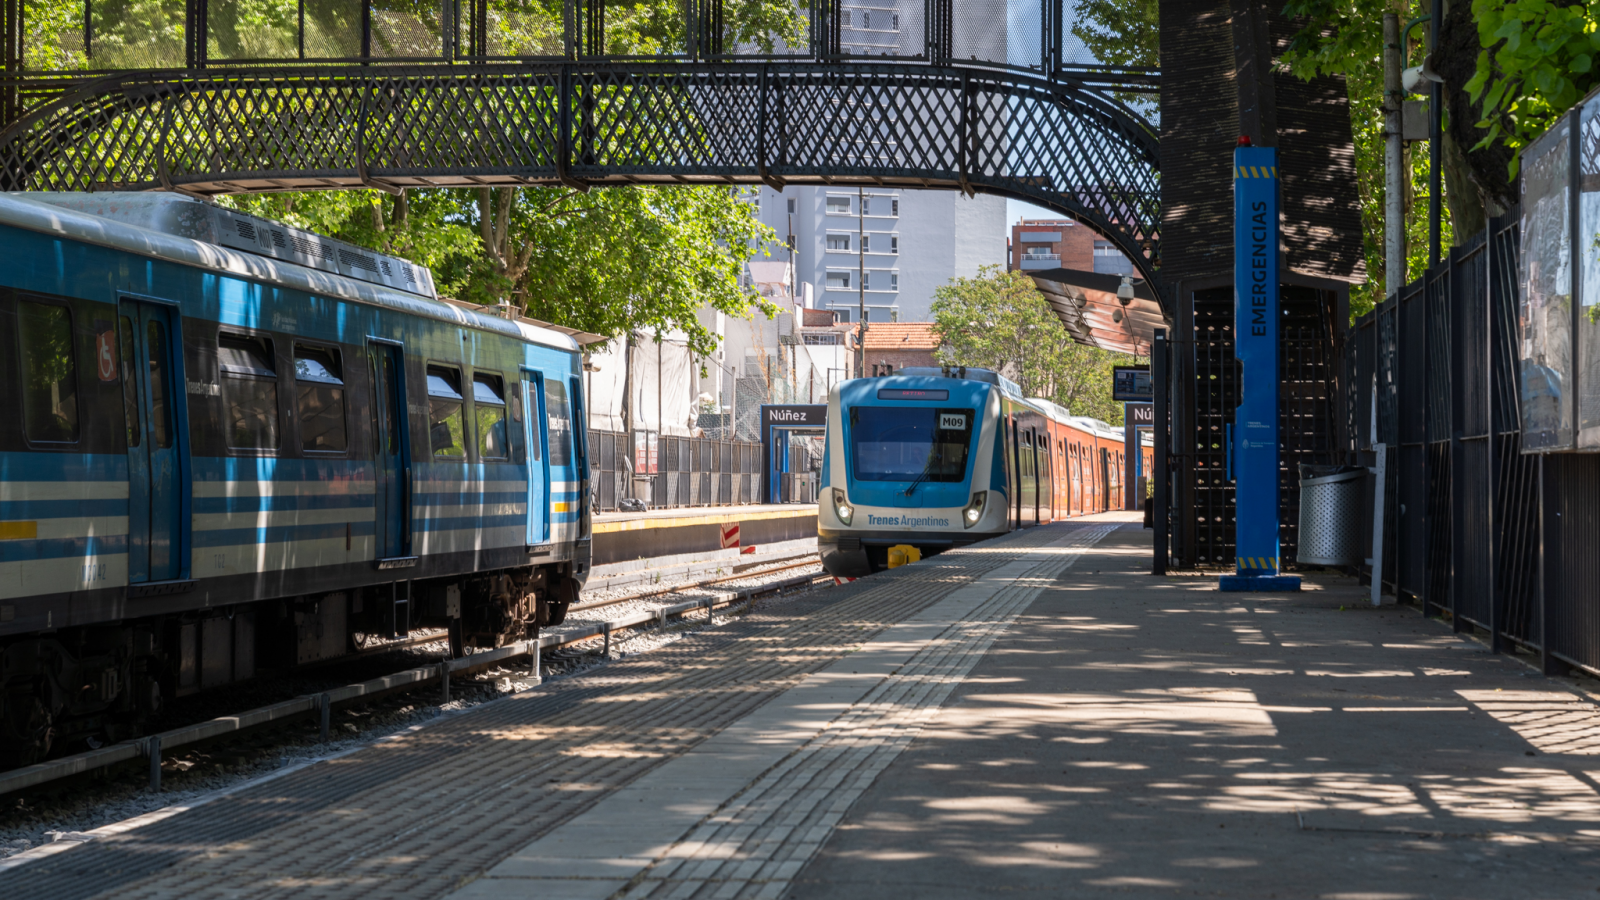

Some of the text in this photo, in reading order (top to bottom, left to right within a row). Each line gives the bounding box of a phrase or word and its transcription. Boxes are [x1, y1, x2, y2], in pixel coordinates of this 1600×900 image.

[1252, 201, 1267, 336] EMERGENCIAS
[769, 409, 807, 421] Núñez
[942, 417, 963, 428] M09
[868, 514, 949, 528] Trenes Argentinos
